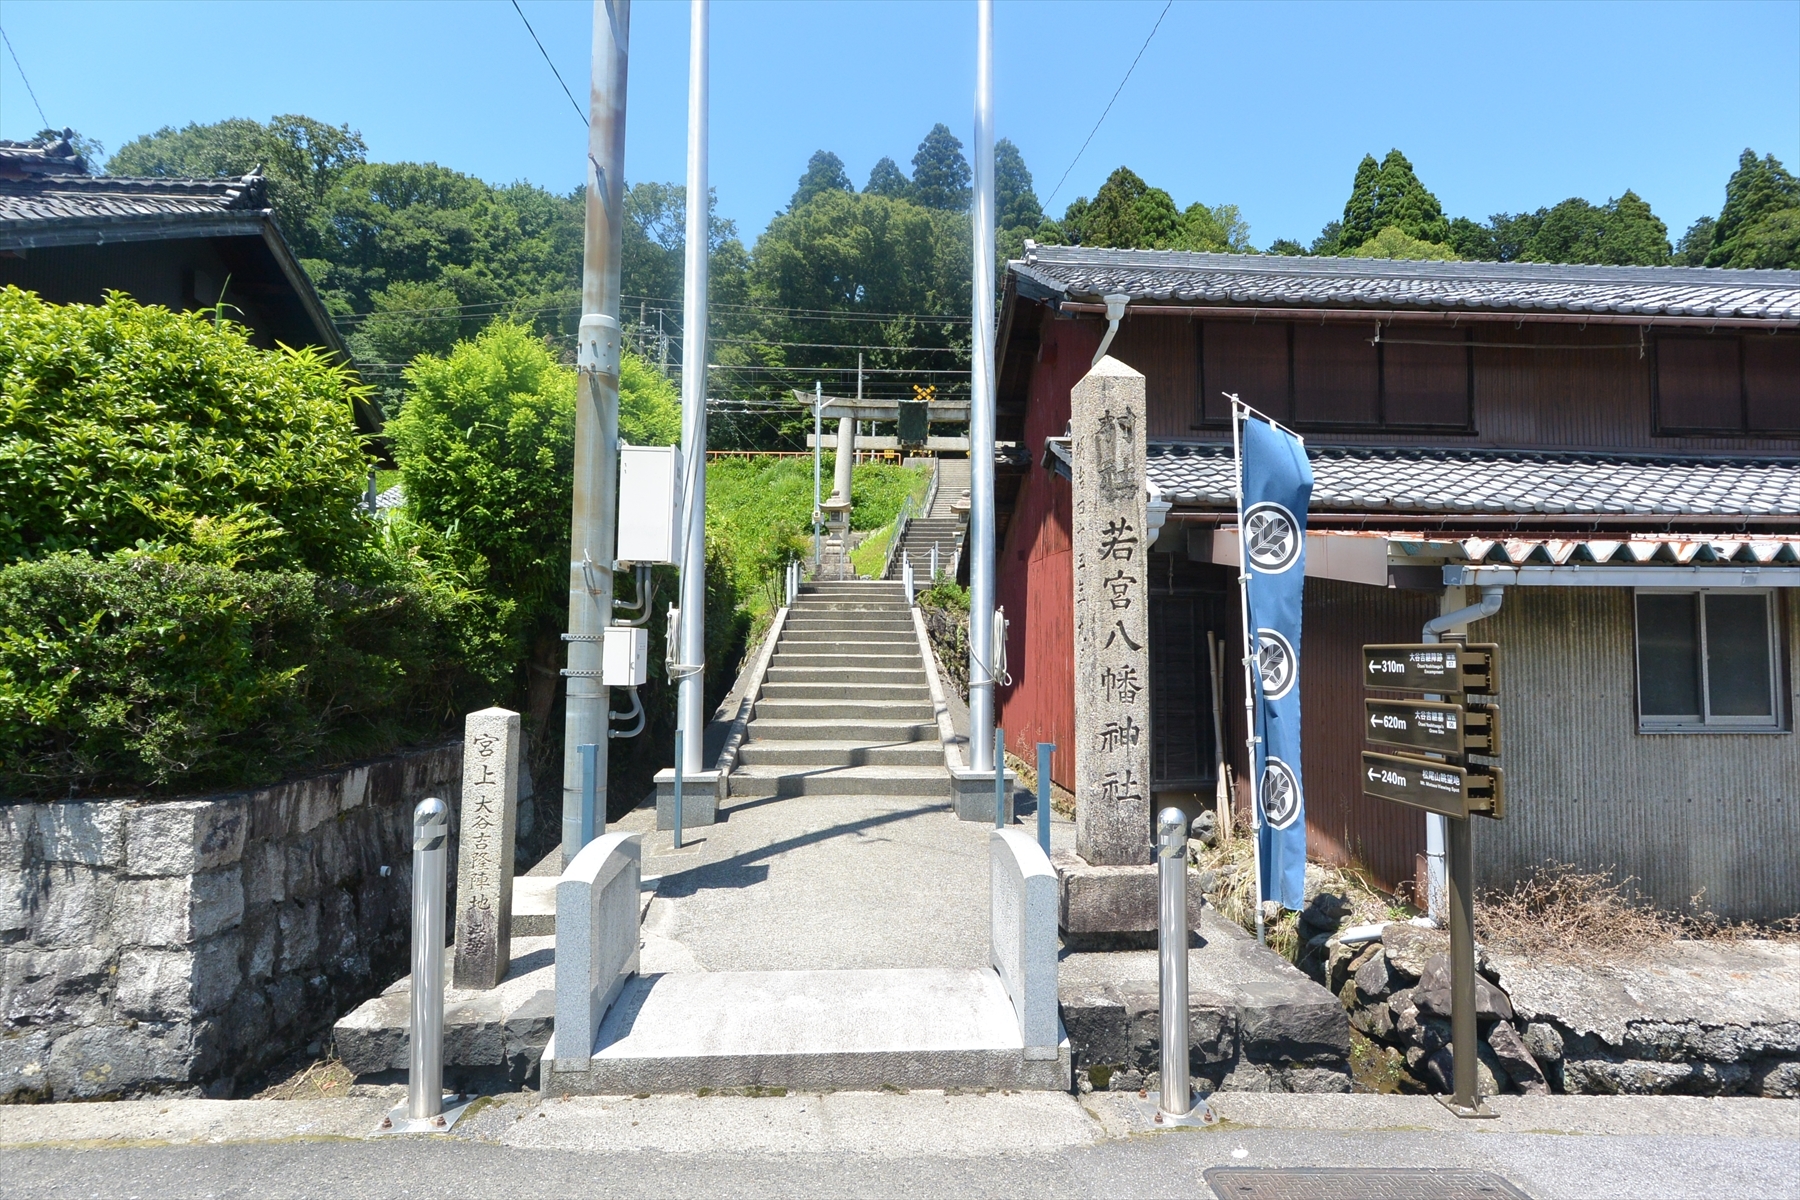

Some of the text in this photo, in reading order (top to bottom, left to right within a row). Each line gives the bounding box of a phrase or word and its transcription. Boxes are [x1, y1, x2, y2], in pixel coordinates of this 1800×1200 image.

[1381, 660, 1405, 673] 310m
[1383, 716, 1407, 730] 620m
[1381, 770, 1407, 787] 240m
